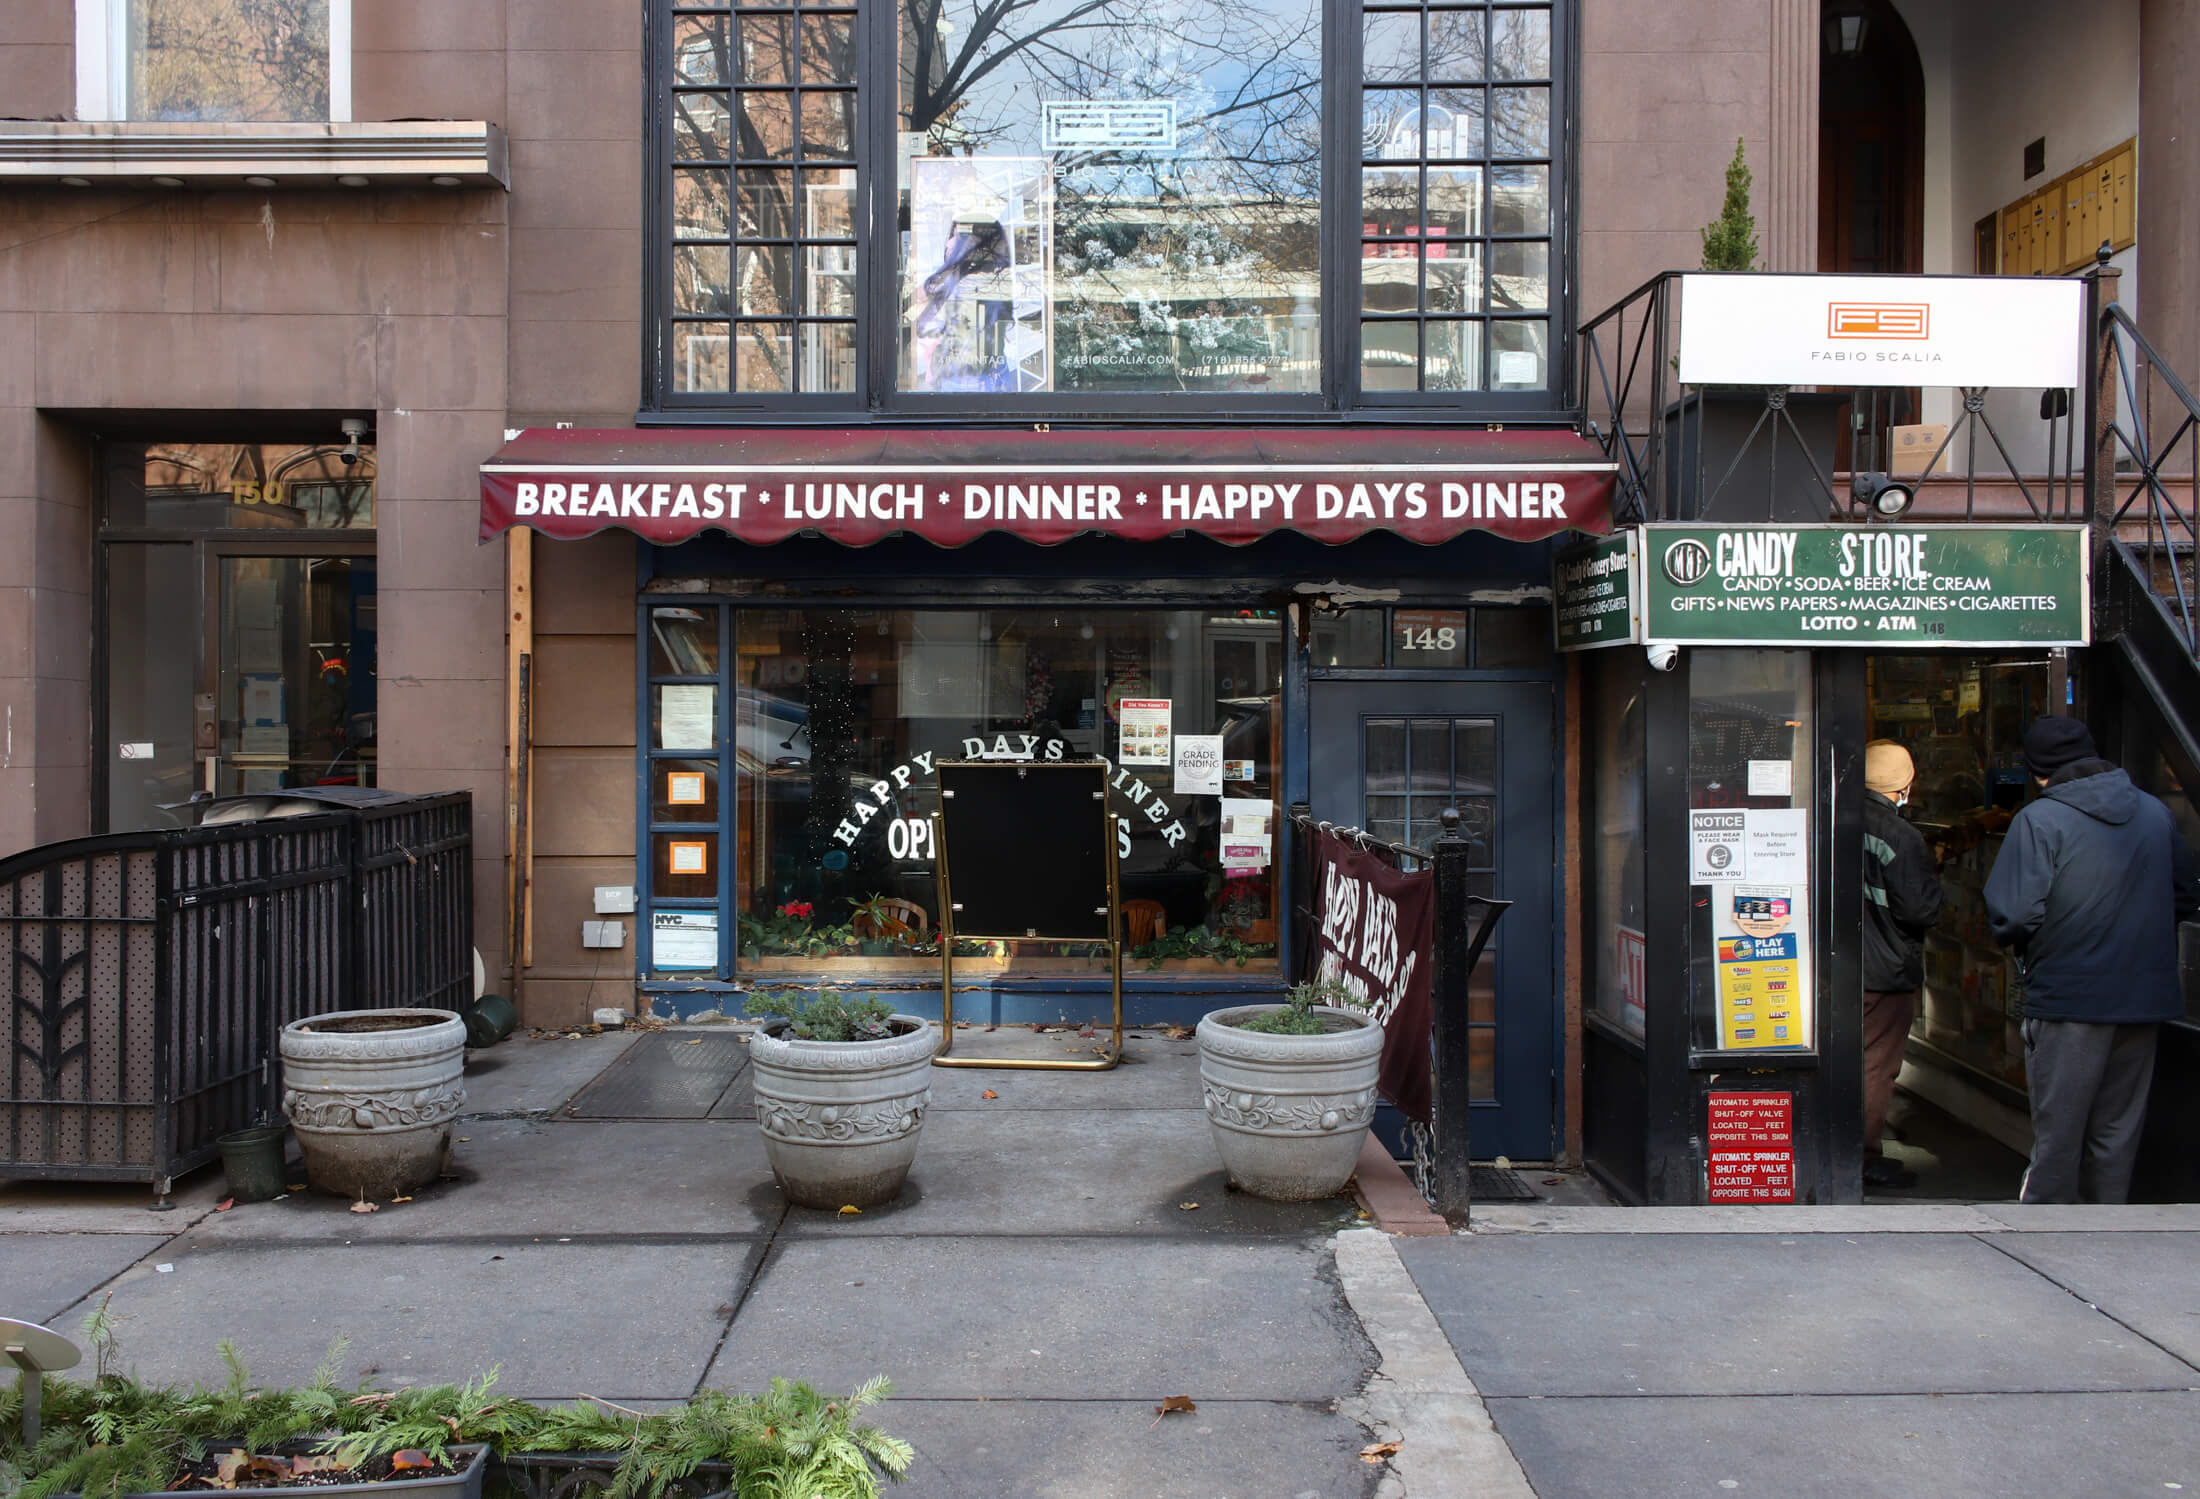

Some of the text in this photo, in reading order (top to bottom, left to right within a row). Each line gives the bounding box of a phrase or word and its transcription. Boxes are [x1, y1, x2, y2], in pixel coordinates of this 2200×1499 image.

[1038, 166, 1096, 178] ABIO
[1066, 355, 1175, 365] FABIOSCALIA.COM
[1201, 355, 1231, 366] (718)
[1811, 352, 1942, 362] FABIO SCALIA
[232, 480, 284, 504] 150
[515, 482, 1568, 520] BREAKFAST LUNCH DINNER HAPPY DAYS DINER
[1716, 531, 1797, 577] CANDY
[1610, 551, 1628, 573] Store
[1722, 576, 1991, 592] CANDY SODA BEER ICE CREAM
[1671, 595, 2057, 612] GIFTS NEWS PAPERS MAGAZINES CIGARETTES
[1801, 616, 1917, 630] LOTTO ATM
[1402, 627, 1456, 651] 148
[1183, 751, 1216, 759] GRADE
[1178, 760, 1220, 768] PENDING
[833, 750, 936, 847] HAPPY
[962, 734, 1064, 760] DAYS
[1694, 816, 1743, 828] NOTICE
[655, 914, 683, 925] NYC
[1755, 938, 1783, 948] PLAY
[1756, 947, 1784, 957] HERE
[1708, 1098, 1789, 1106] AUTOMATIC SPRINKLER
[1711, 1152, 1790, 1162] AUTOMATIC SPRINKLER
[1715, 1164, 1787, 1173] SHUT-OFF VALVE
[1713, 1176, 1788, 1186] LOCATED FEET
[1712, 1188, 1791, 1197] OPPOSITE THIS SIGN
